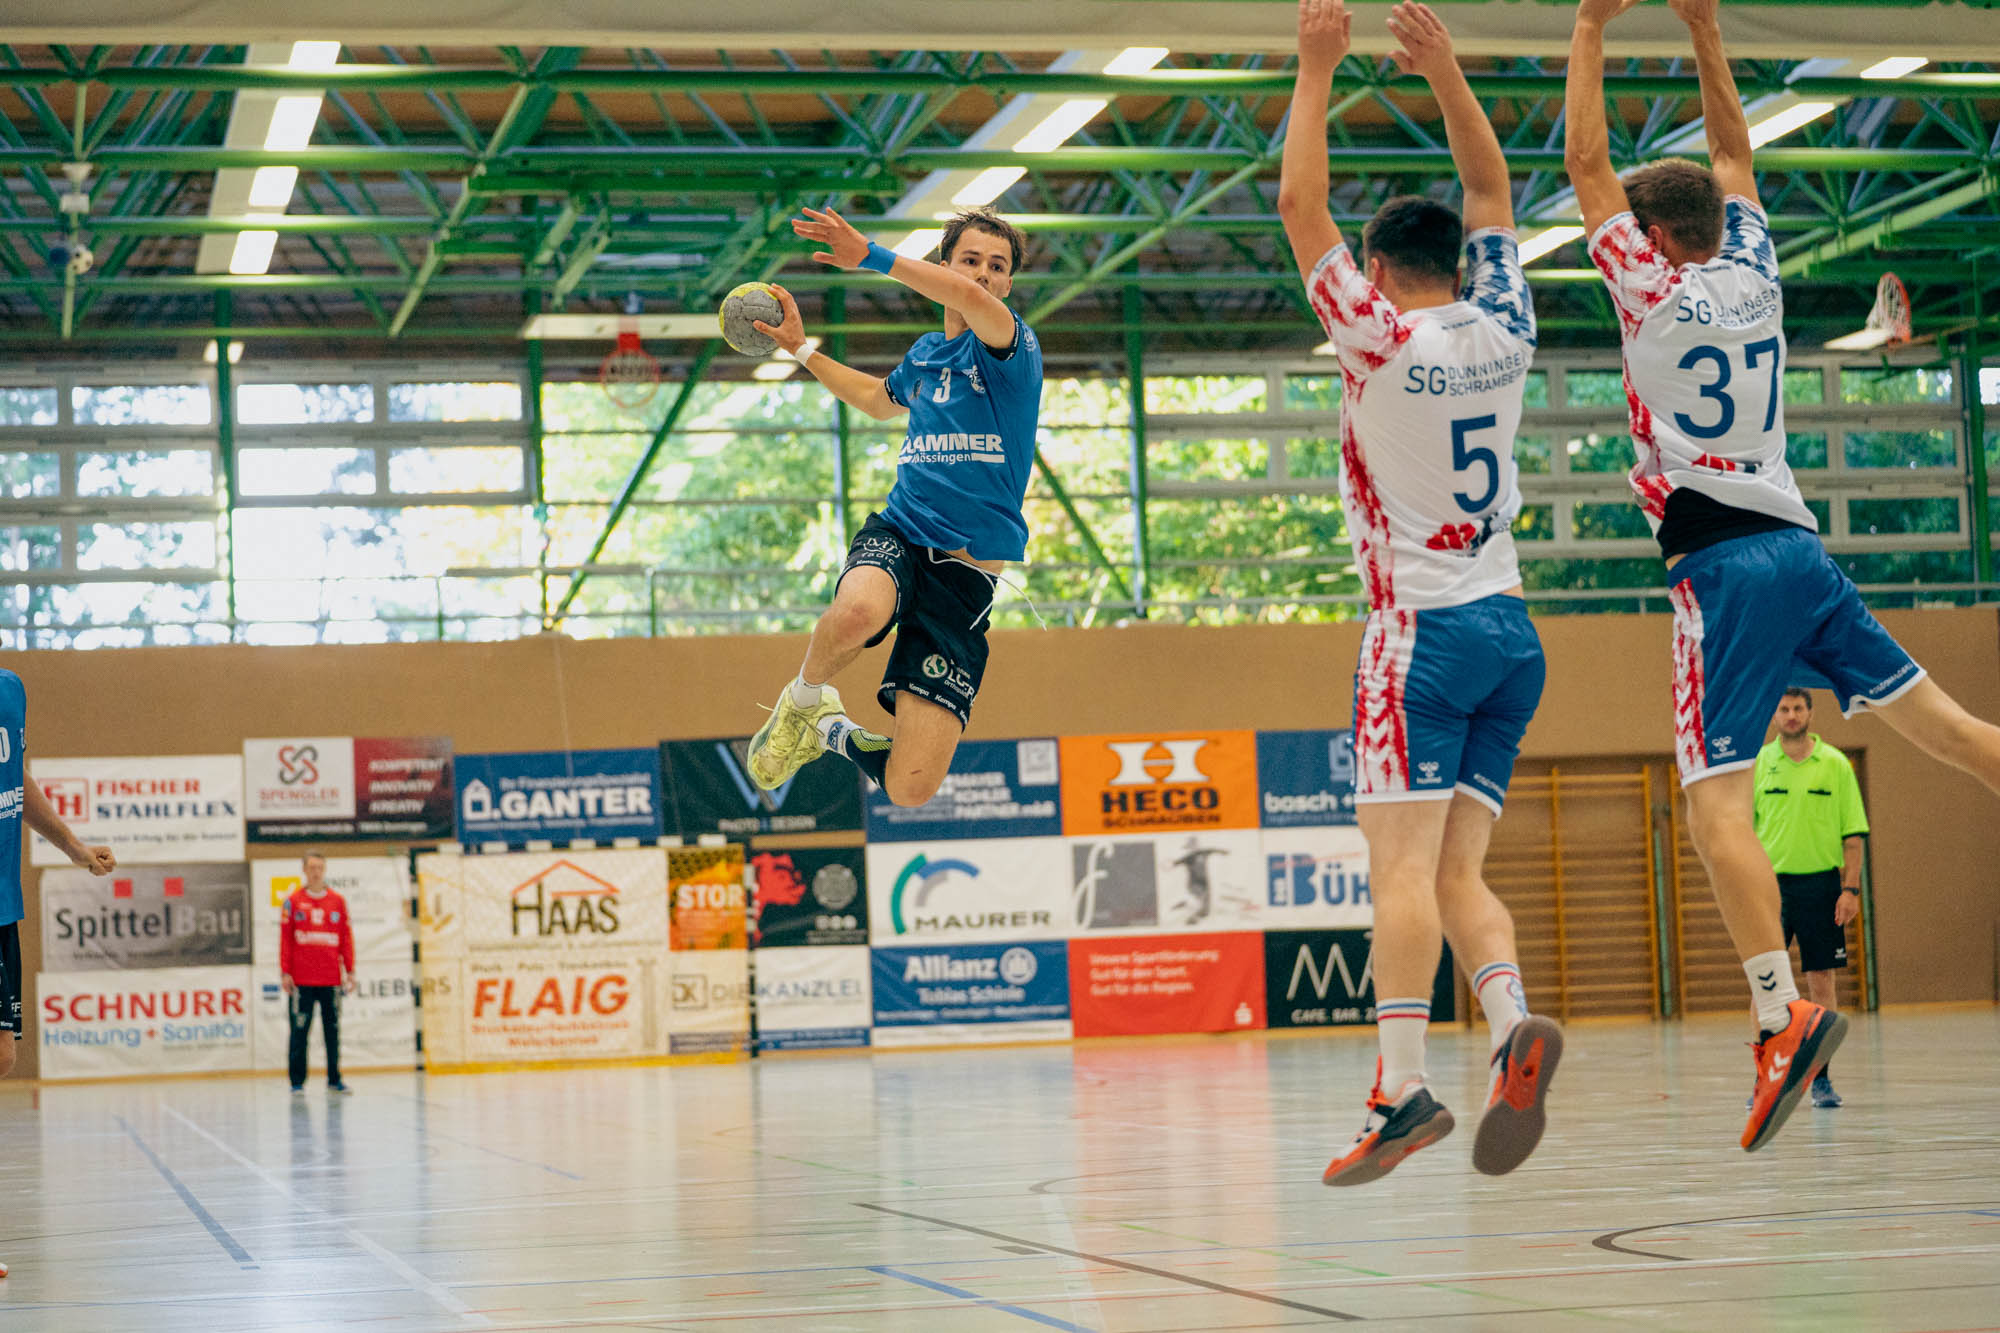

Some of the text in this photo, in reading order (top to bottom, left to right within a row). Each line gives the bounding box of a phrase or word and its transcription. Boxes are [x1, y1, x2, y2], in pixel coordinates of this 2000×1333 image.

[1676, 296, 1712, 326] SG
[1448, 352, 1528, 380] DUNNINGE
[932, 367, 951, 403] 3
[1404, 365, 1446, 395] SG
[1674, 336, 1780, 439] 37
[1450, 413, 1500, 514] 5
[908, 682, 930, 697] Kempa
[935, 694, 957, 710] Kempa
[97, 778, 200, 796] FISCHER
[259, 787, 340, 802] SPENGLER
[1100, 787, 1219, 814] HECO
[97, 801, 237, 820] STAHLFLEX
[1264, 791, 1337, 814] bosch
[1103, 813, 1221, 828] SCHRAUBEN
[511, 878, 620, 937] HAAS
[678, 884, 758, 910] STOR
[56, 903, 242, 948] SpittelBau
[915, 911, 1052, 931] MAURER
[904, 954, 999, 982] Allianz
[473, 974, 629, 1019] FLAIG
[757, 979, 862, 998] KANZLEI
[918, 987, 968, 1005] Tobias
[43, 988, 245, 1024] SCHNURR
[44, 1027, 141, 1048] Heizung
[163, 1020, 245, 1042] Sanitär
